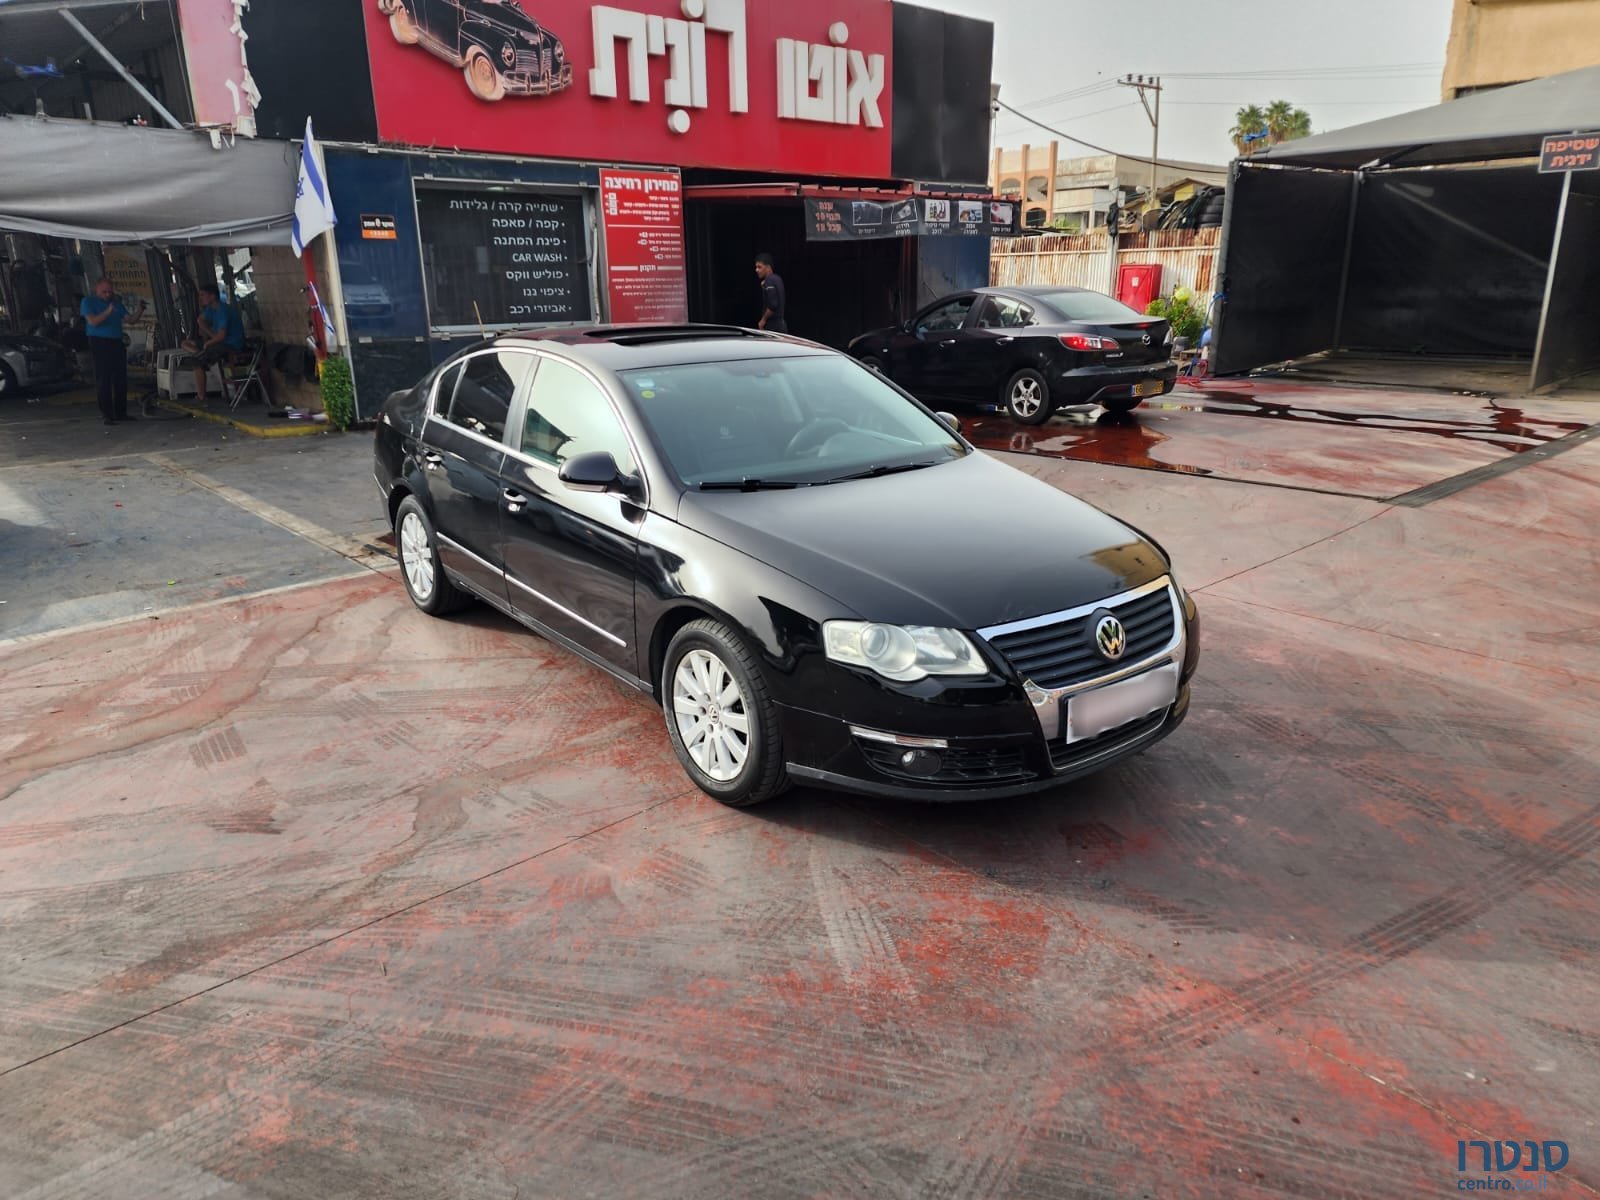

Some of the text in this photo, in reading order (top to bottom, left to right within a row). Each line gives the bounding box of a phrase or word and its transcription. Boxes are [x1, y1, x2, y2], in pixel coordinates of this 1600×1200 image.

[589, 0, 885, 134] אוטו רונית
[1550, 153, 1593, 168] ידנית
[604, 176, 679, 194] מחירון רחיצה
[449, 199, 489, 211] גלידות
[498, 202, 522, 214] קרה
[525, 203, 558, 213] שתייה
[492, 218, 526, 228] מאפה
[535, 219, 559, 231] קפה
[493, 236, 561, 246] פינת המתנה
[512, 253, 562, 262] CAR WASH
[505, 269, 563, 282] פוליש ווקס
[523, 287, 565, 297] ציפוי ננו
[509, 303, 567, 314] אביזרי רכב
